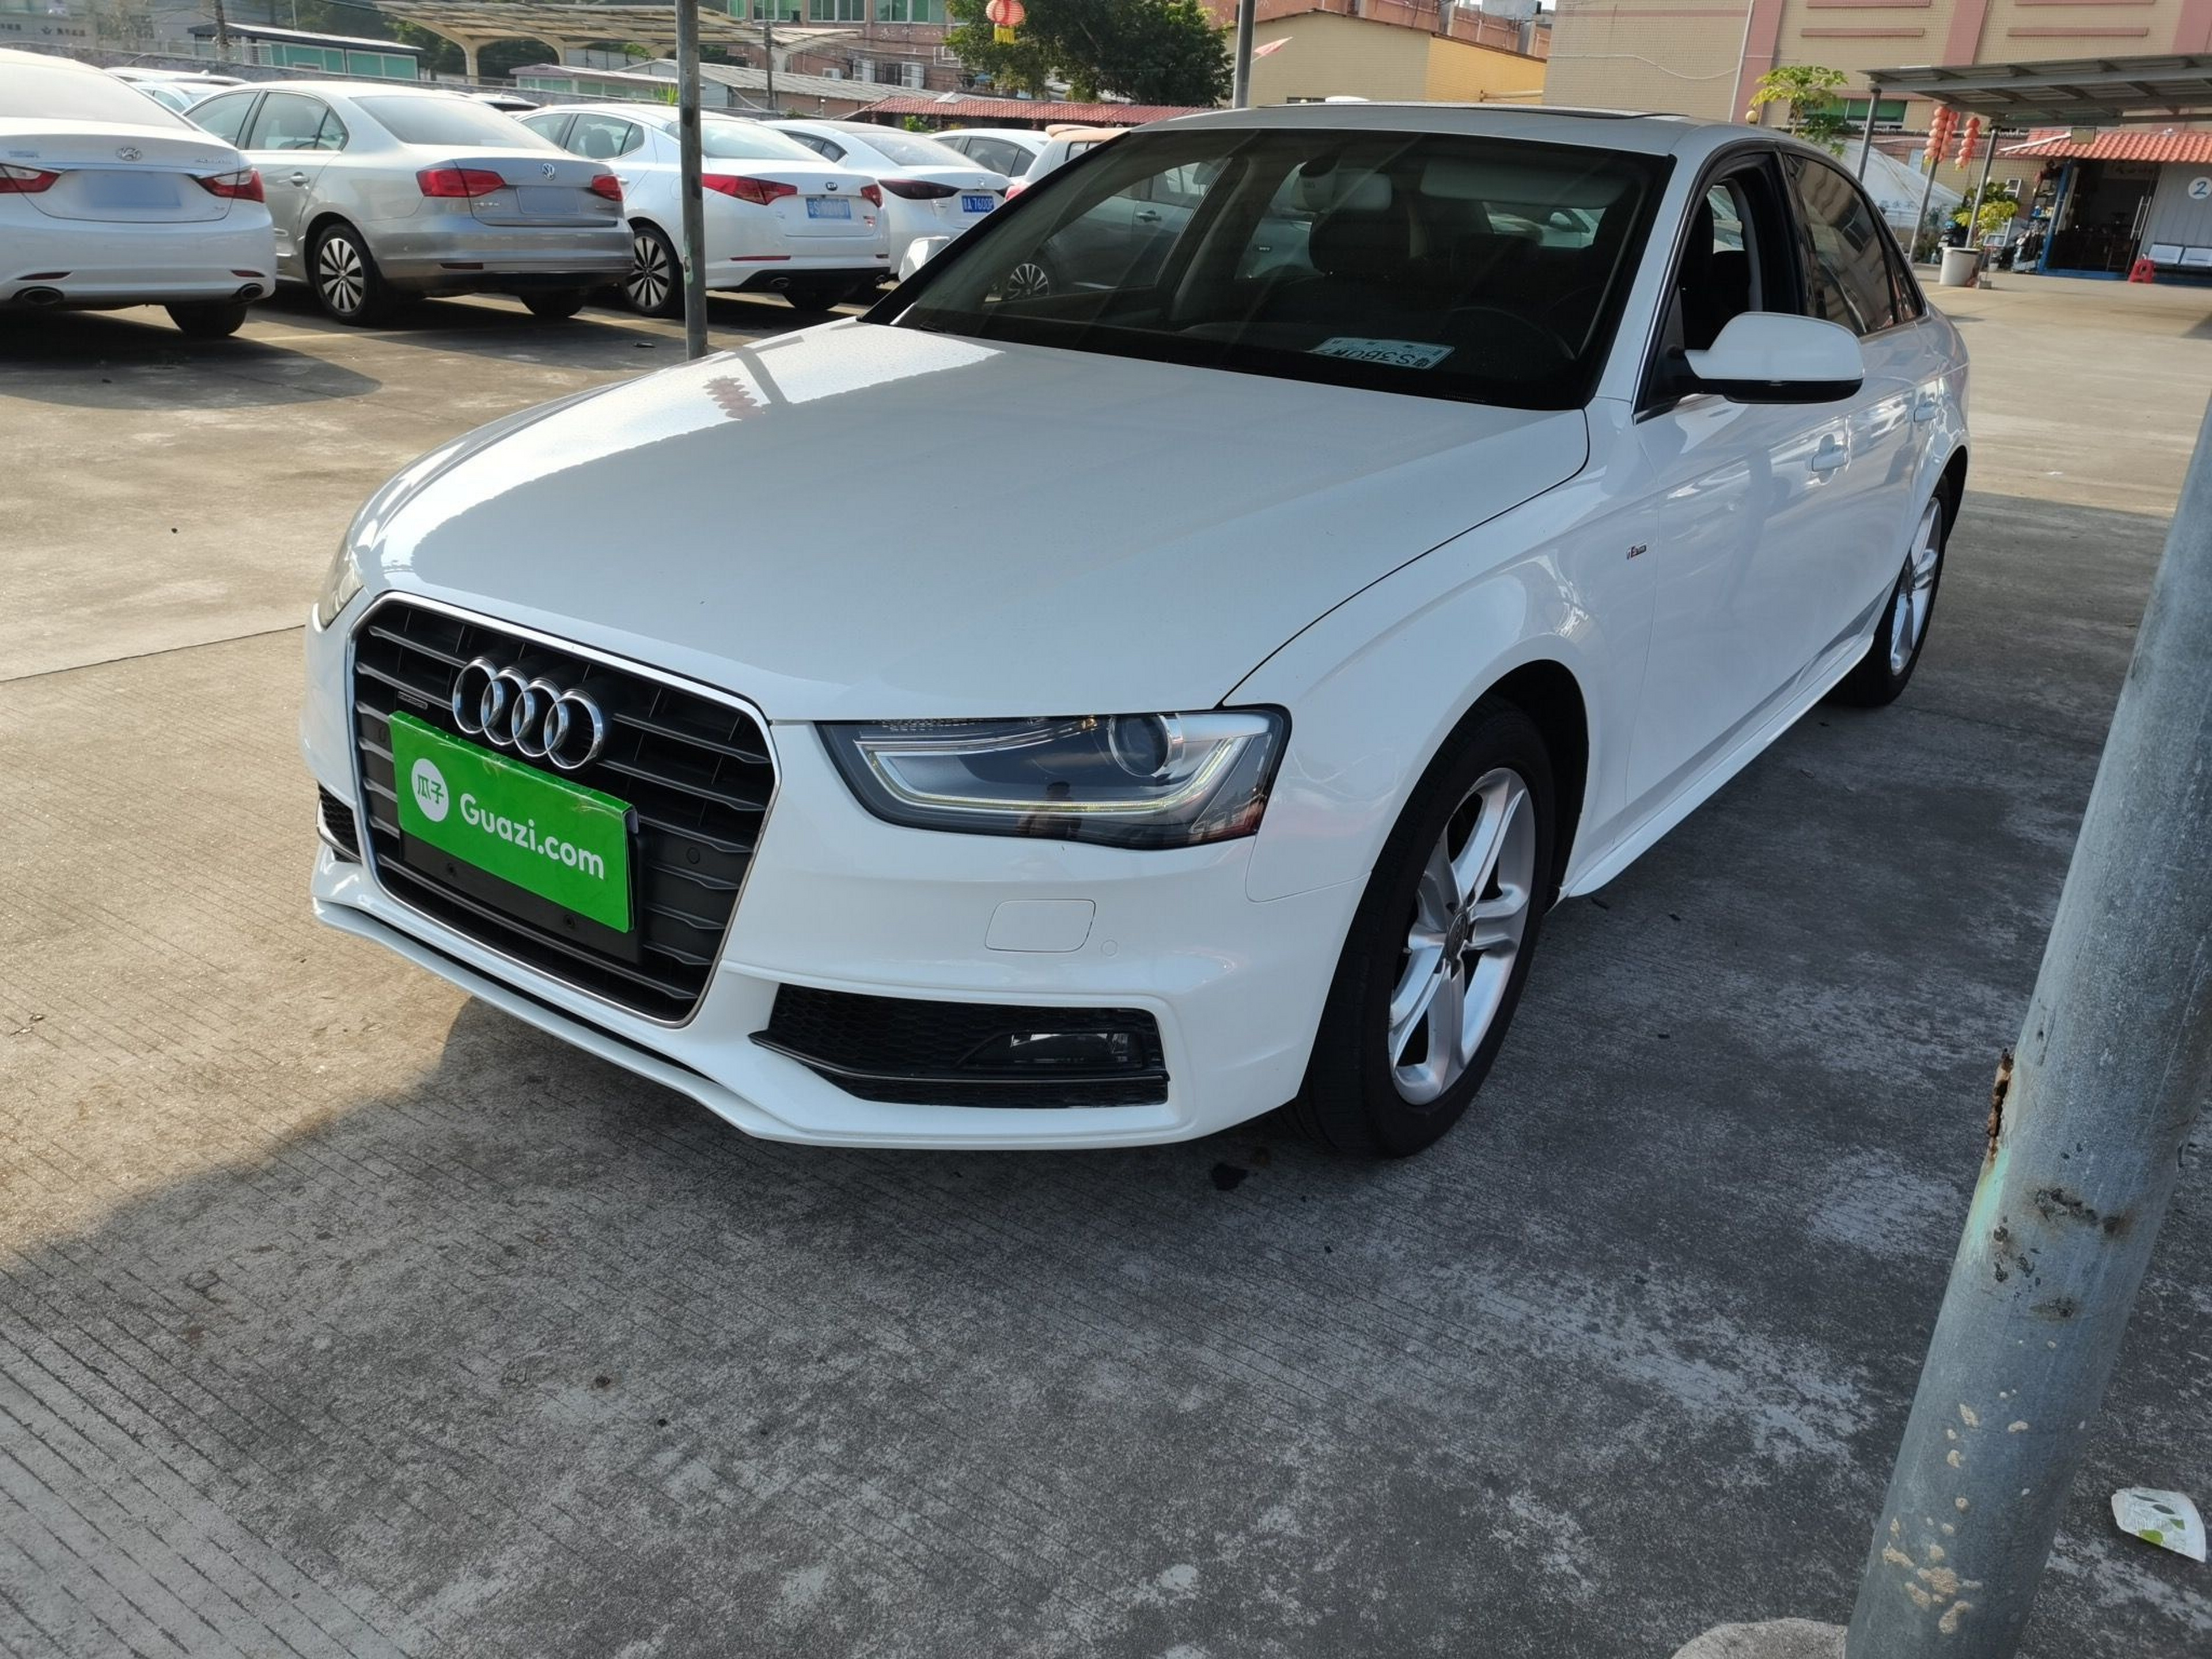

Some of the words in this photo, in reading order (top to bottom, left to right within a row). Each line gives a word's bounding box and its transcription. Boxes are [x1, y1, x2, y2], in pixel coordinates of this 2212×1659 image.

[2193, 181, 2207, 195] 2
[417, 774, 444, 805] 瓜子
[460, 793, 604, 880] Guazi.com
